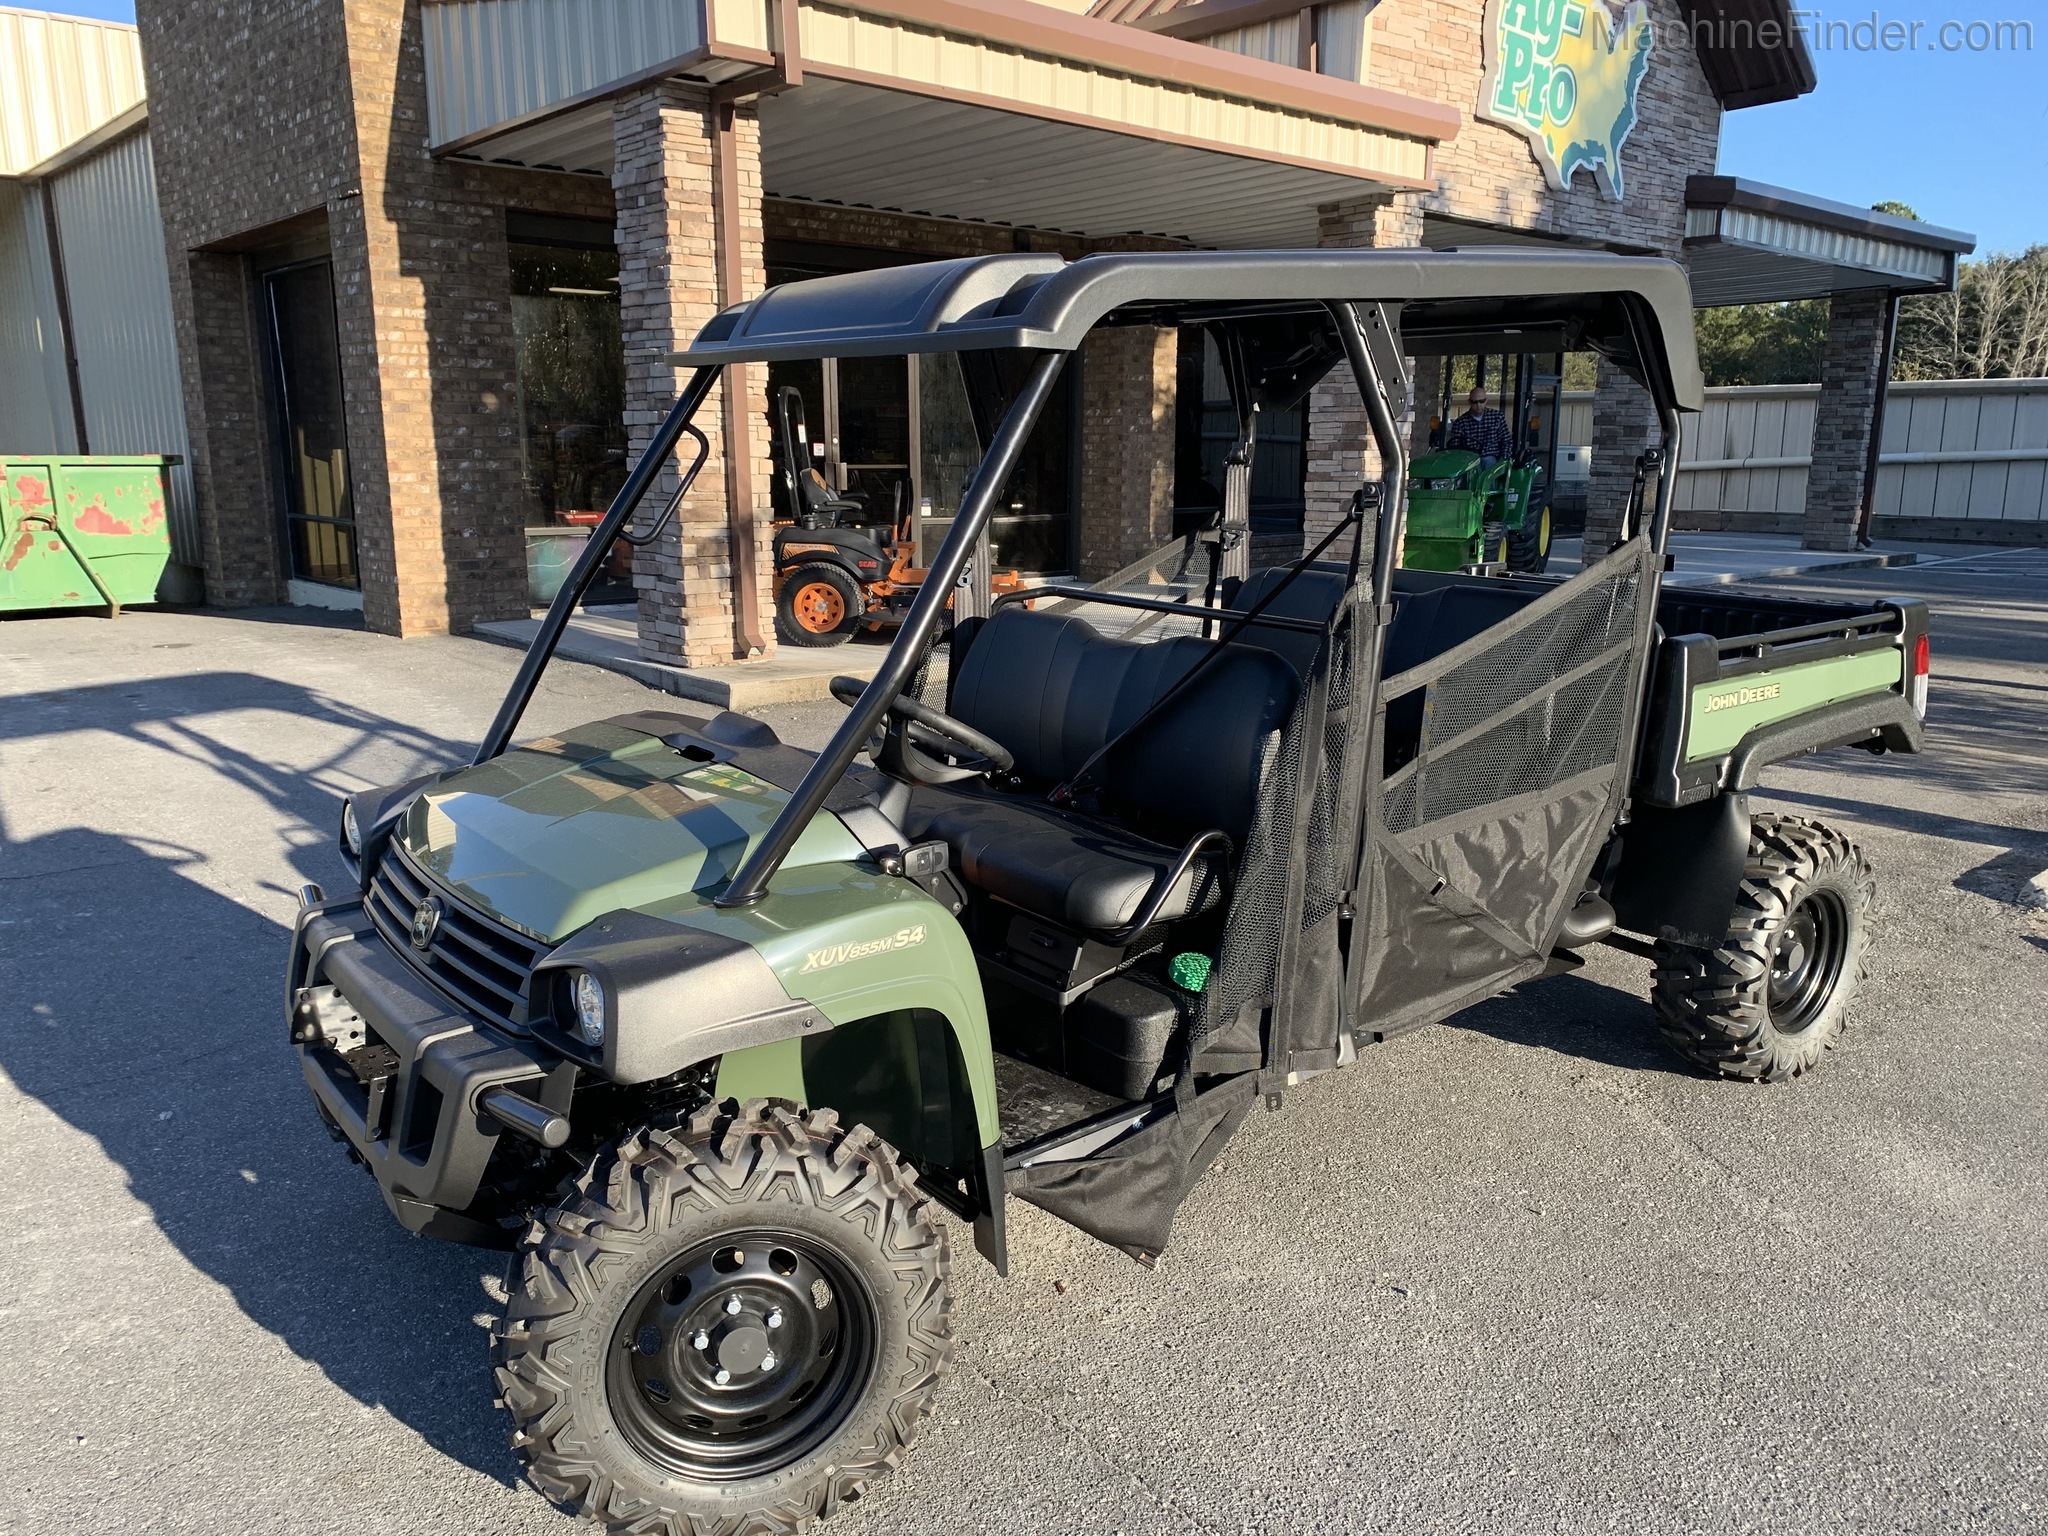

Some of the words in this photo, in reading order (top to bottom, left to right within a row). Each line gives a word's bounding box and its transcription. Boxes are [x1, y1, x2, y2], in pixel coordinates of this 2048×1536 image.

[1494, 29, 1577, 126] Pro
[858, 560, 877, 568] SCAG
[1704, 693, 1738, 713] JOHN
[1740, 683, 1780, 705] DEERE
[801, 937, 894, 973] XUV855M
[894, 924, 926, 948] S4
